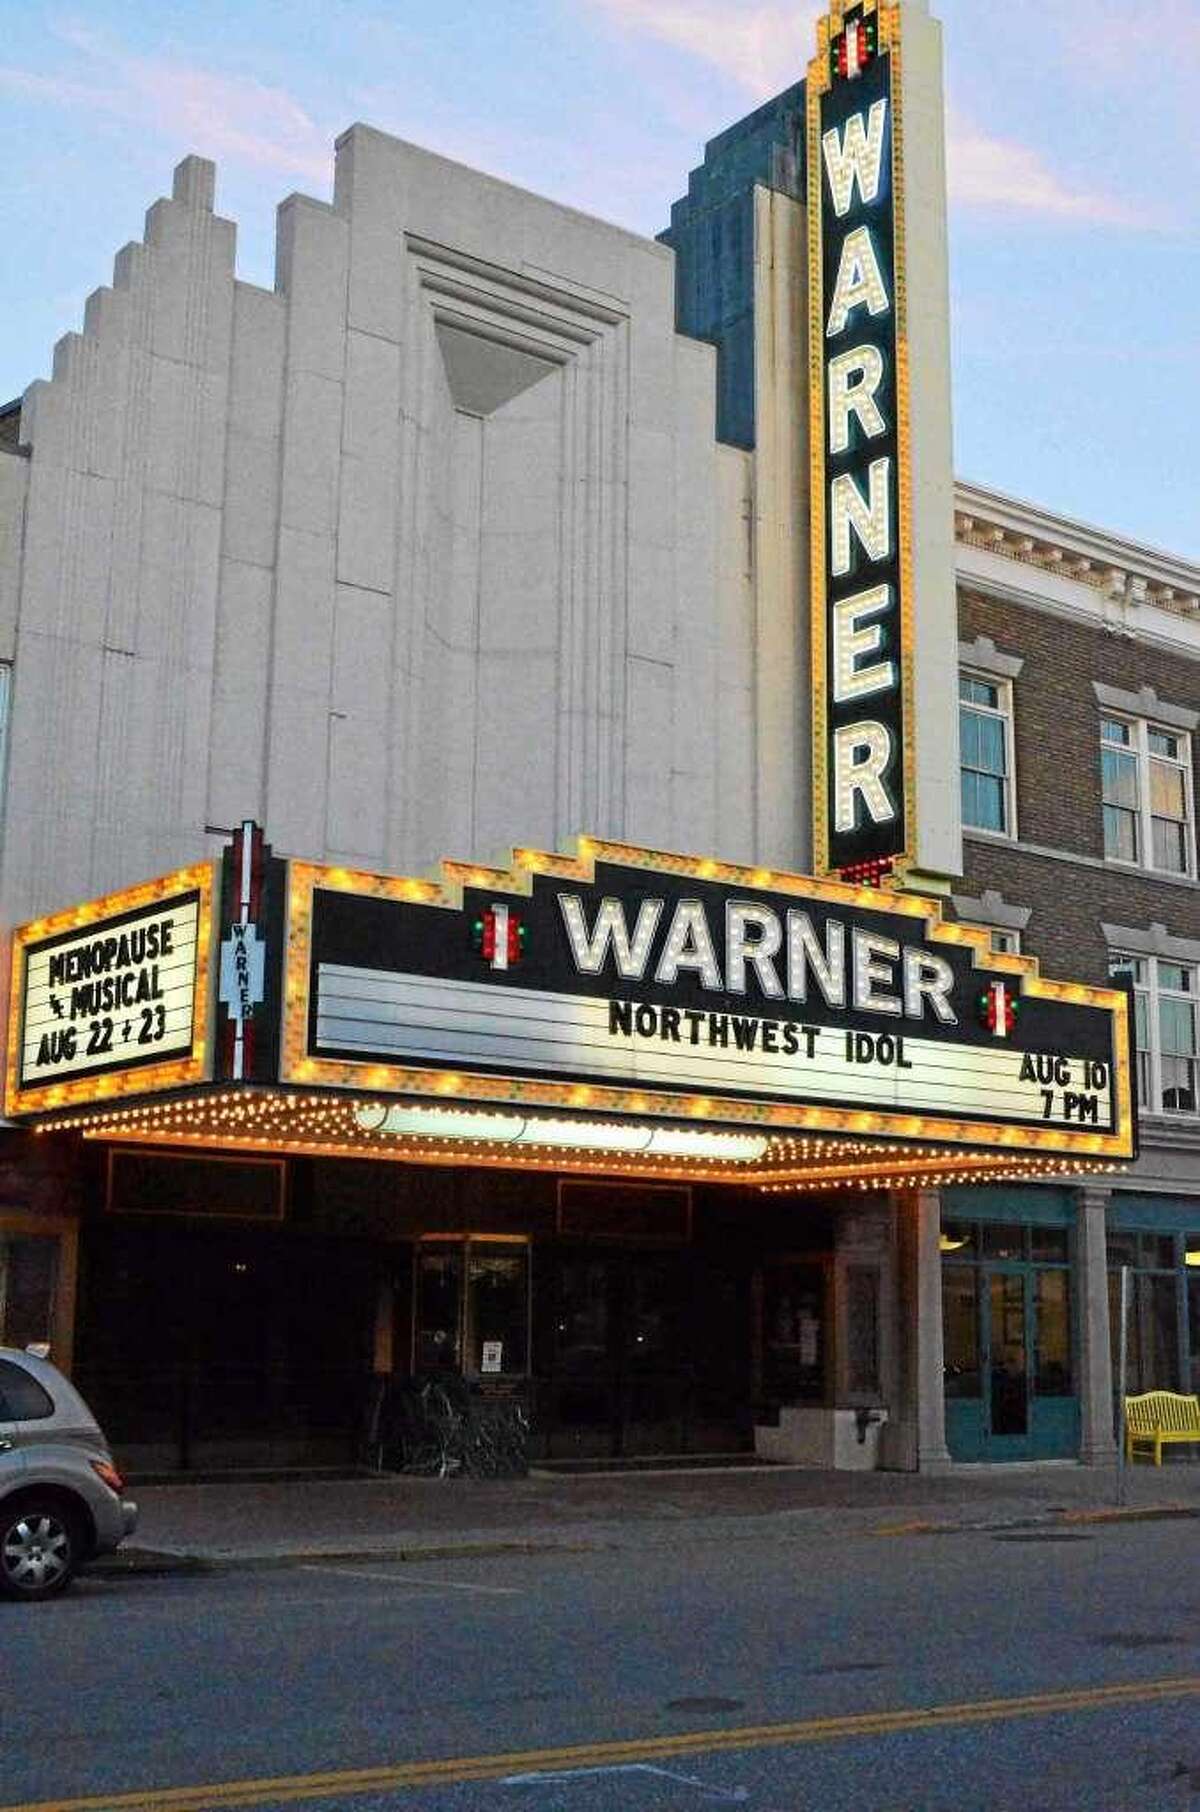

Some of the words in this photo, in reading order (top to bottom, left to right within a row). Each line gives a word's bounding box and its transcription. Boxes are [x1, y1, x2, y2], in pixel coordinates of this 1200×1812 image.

[822, 98, 896, 833] WARNER
[49, 919, 174, 988] MENOPAUSE
[233, 925, 254, 1018] WARNER
[557, 893, 959, 1026] WARNER
[70, 965, 164, 1021] MUSICAL
[36, 1026, 77, 1066] AUG
[86, 1017, 113, 1056] 22
[138, 1005, 165, 1044] 23
[608, 1001, 822, 1059] NORTHWEST
[845, 1031, 913, 1069] IDOL
[1018, 1052, 1071, 1087] AUG
[1084, 1060, 1107, 1090] 10
[1040, 1089, 1054, 1119] 7
[1063, 1091, 1099, 1124] PM
